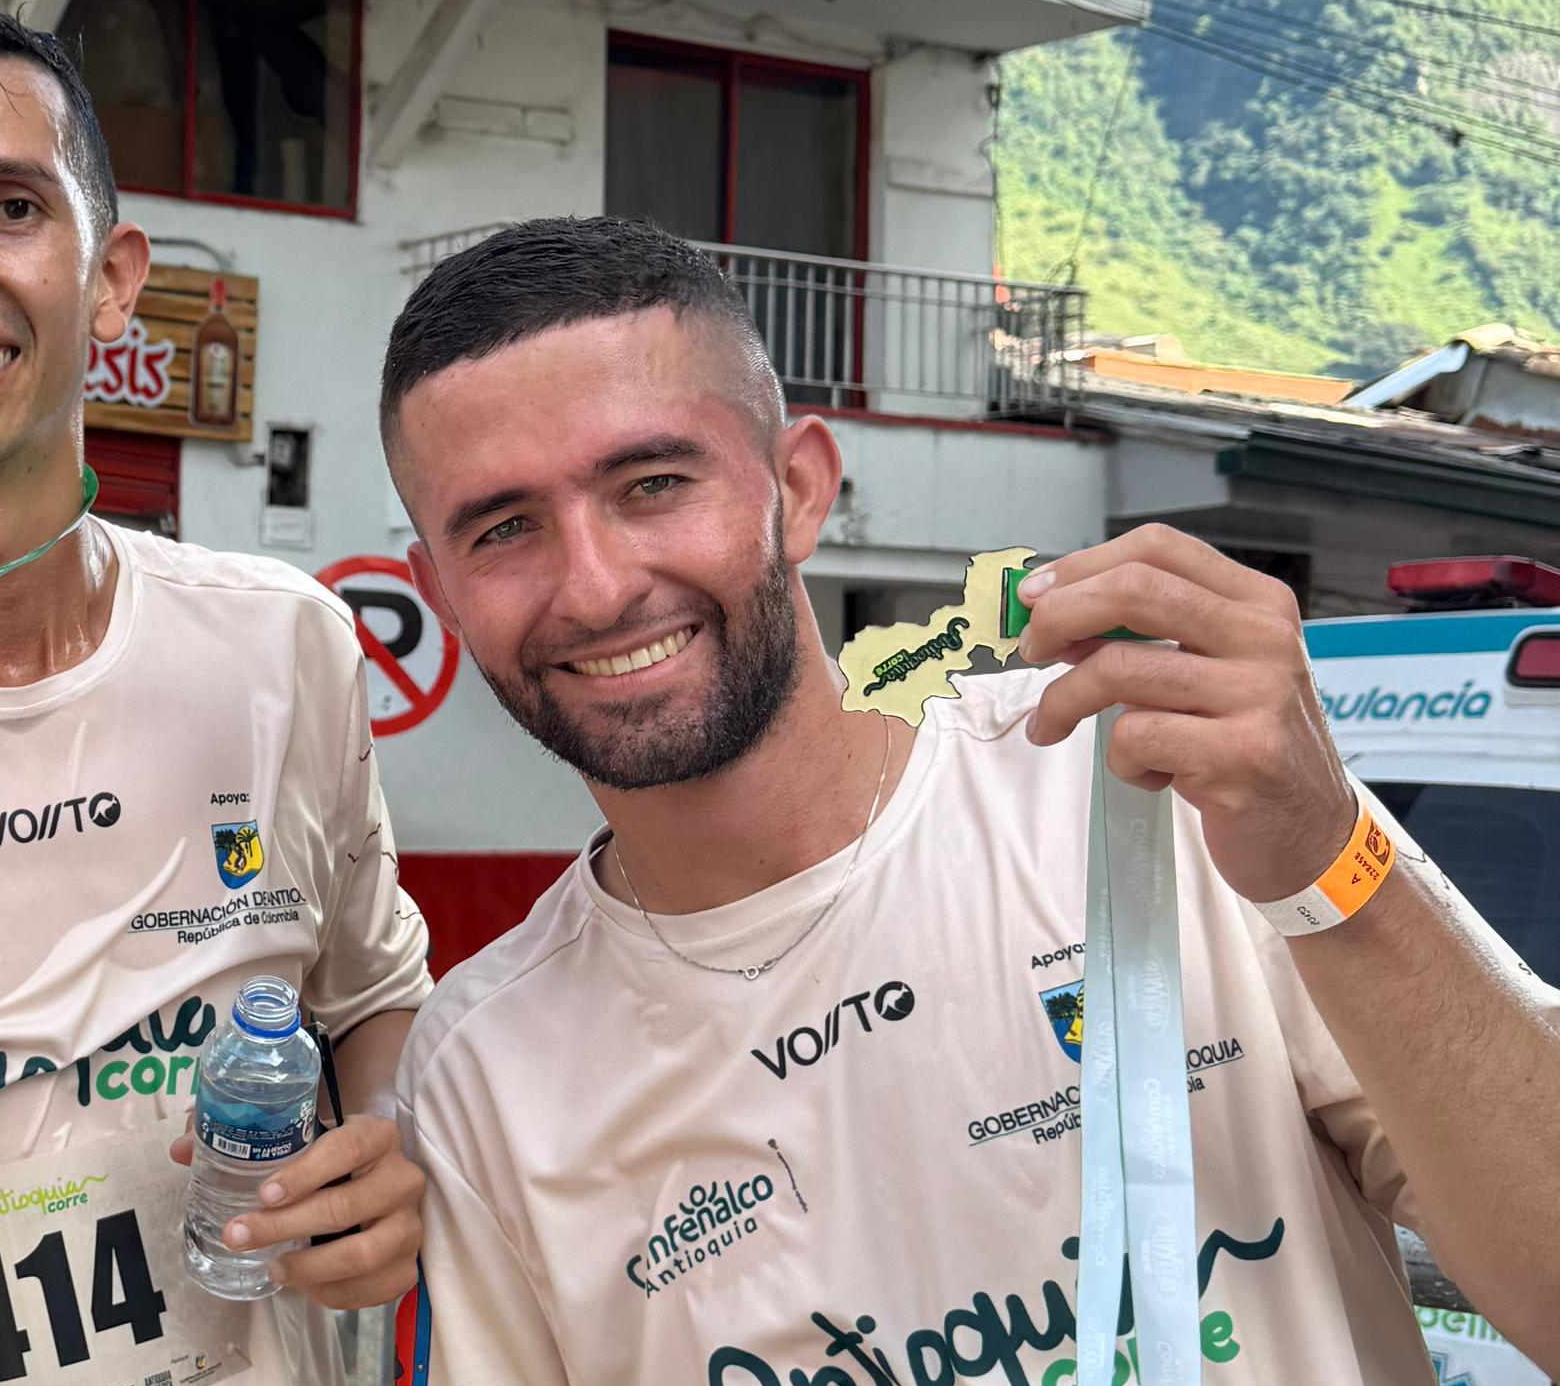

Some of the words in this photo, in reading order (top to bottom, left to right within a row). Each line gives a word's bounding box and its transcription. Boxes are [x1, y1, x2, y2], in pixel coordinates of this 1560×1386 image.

[1321, 679, 1493, 721] bulancia
[968, 1086, 1081, 1141] GOBERNAC
[1031, 1114, 1081, 1144] Repúb
[47, 1192, 89, 1214] corre
